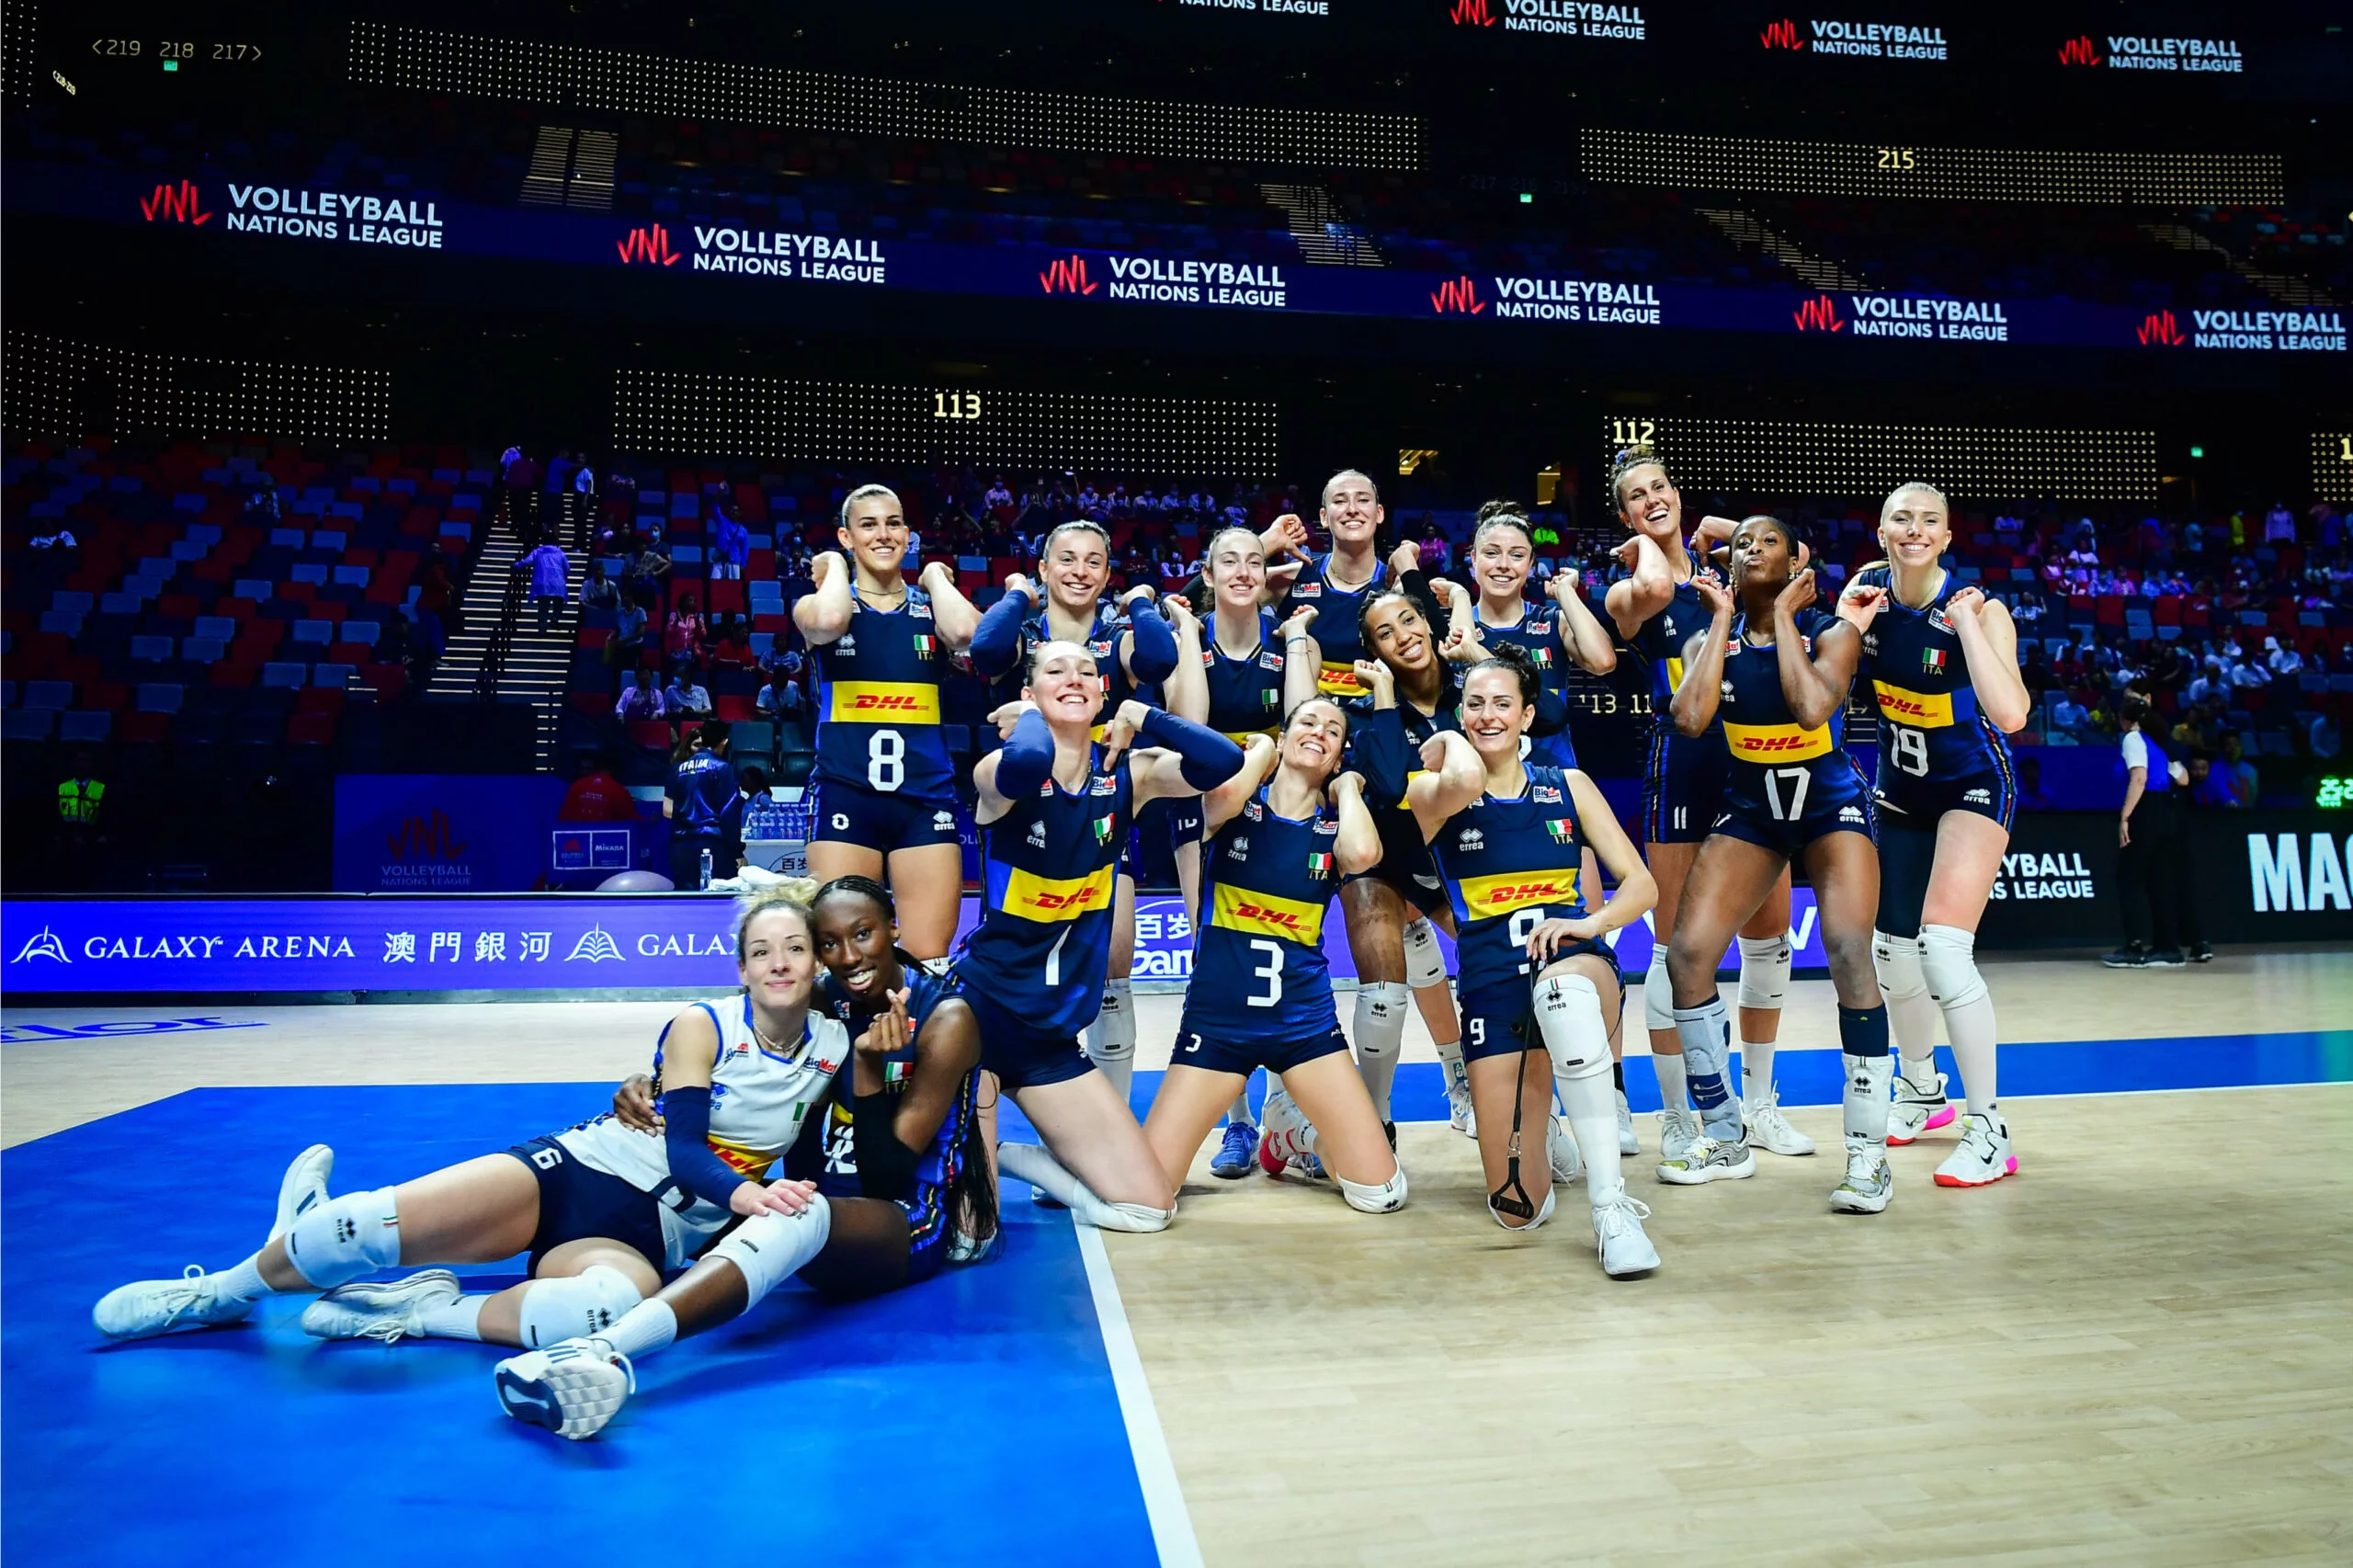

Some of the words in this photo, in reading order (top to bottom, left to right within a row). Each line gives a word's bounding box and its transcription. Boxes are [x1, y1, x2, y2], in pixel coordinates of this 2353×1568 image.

[1263, 0, 1329, 16] LEAGUE
[1505, 0, 1645, 25] VOLLEYBALL
[1505, 17, 1577, 35] NATIONS
[1583, 23, 1645, 40] LEAGUE
[1811, 20, 1947, 44] VOLLEYBALL
[106, 40, 141, 56] 219
[159, 41, 194, 58] 218
[212, 43, 247, 60] 217
[1812, 40, 1881, 56] NATIONS
[1886, 46, 1948, 60] LEAGUE
[2108, 36, 2242, 57] VOLLEYBALL
[2109, 55, 2177, 71] NATIONS
[2182, 58, 2243, 73] LEAGUE
[1876, 149, 1915, 169] 215
[228, 184, 443, 227] VOLLEYBALL
[227, 212, 338, 240] NATIONS
[348, 223, 443, 249] LEAGUE
[694, 226, 885, 263] VOLLEYBALL
[693, 253, 792, 277] NATIONS
[801, 261, 885, 284] LEAGUE
[1109, 256, 1286, 288] VOLLEYBALL
[1109, 281, 1200, 302] NATIONS
[1208, 287, 1286, 307] LEAGUE
[1495, 277, 1660, 306] VOLLEYBALL
[1495, 301, 1581, 321] NATIONS
[1587, 306, 1661, 324] LEAGUE
[1852, 296, 2007, 324] VOLLEYBALL
[1853, 320, 1933, 338] NATIONS
[1938, 324, 2007, 342] LEAGUE
[2193, 310, 2347, 333] VOLLEYBALL
[2194, 333, 2273, 349] NATIONS
[2278, 335, 2347, 351] LEAGUE
[933, 393, 982, 419] 113
[1612, 421, 1654, 445] 112
[917, 651, 935, 661] ITA
[1536, 661, 1553, 670] ITA
[1320, 670, 1358, 686] HL
[1923, 664, 1943, 676] ITA
[855, 695, 919, 710] DHL
[1877, 693, 1926, 717] DHL
[1742, 735, 1806, 752] DHL
[1890, 723, 1929, 778] 19
[868, 730, 904, 791] 8
[1764, 767, 1812, 821] 17
[1962, 794, 1991, 805] errea
[1839, 814, 1865, 825] errea
[1027, 835, 1046, 850] erre
[1459, 840, 1484, 852] errea
[1553, 834, 1574, 845] ITA
[381, 865, 472, 877] VOLLEYBALL
[1309, 869, 1328, 881] ITA
[1996, 853, 2091, 878] YBALL
[2247, 832, 2353, 913] MA
[381, 877, 426, 887] NATIONS
[430, 876, 472, 886] LEAGUE
[2013, 880, 2095, 900] LEAGUE
[1490, 882, 1560, 904] DHL
[1236, 902, 1301, 930] DHL
[233, 936, 357, 959] ARENA
[1246, 938, 1285, 1007] 3
[1547, 1002, 1567, 1012] errea
[1470, 1017, 1486, 1046] 9
[1853, 1087, 1872, 1096] errea
[532, 1147, 563, 1170] 6
